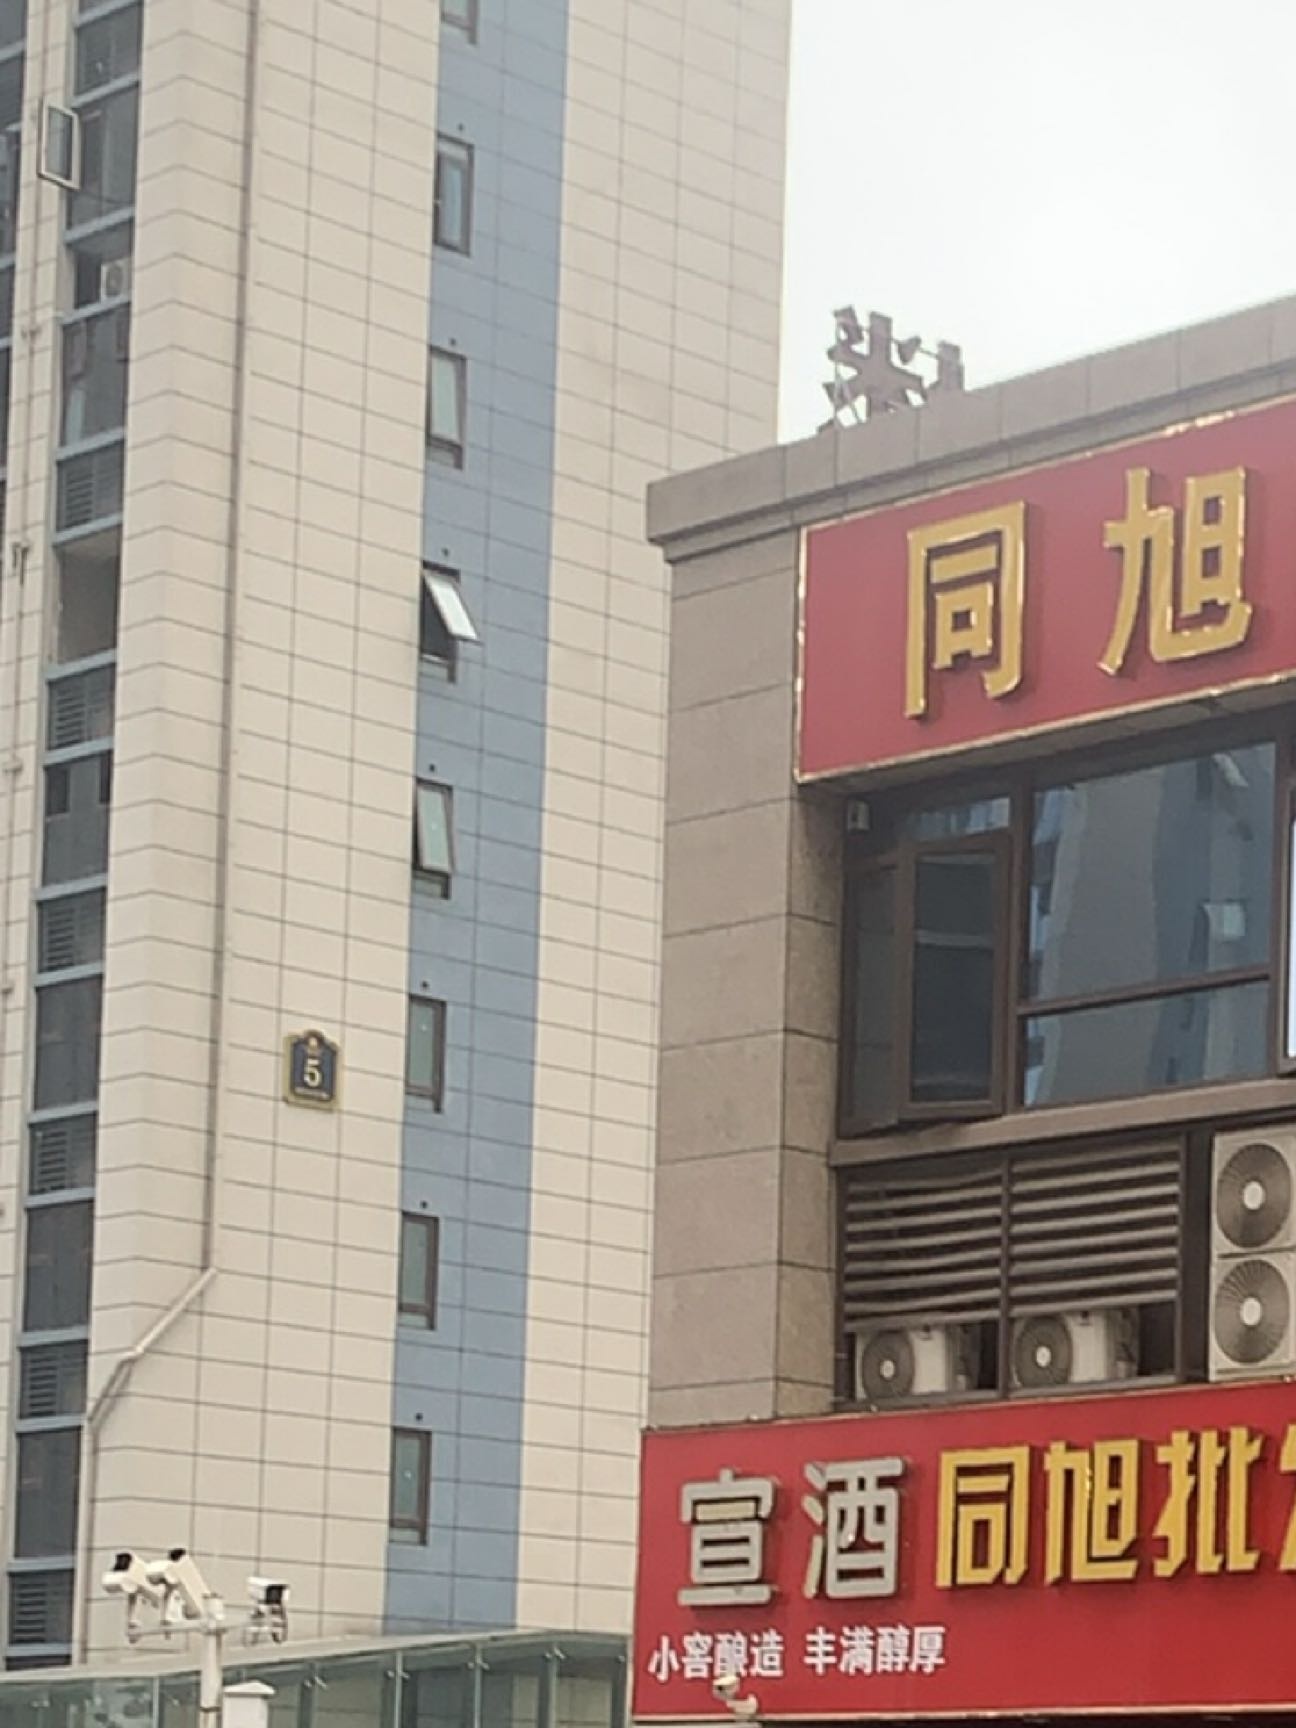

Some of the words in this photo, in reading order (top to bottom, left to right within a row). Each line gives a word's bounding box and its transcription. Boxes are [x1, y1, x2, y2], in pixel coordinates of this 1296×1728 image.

[677, 1456, 908, 1607] 宣酒
[647, 1628, 785, 1683] 小窖酿造
[803, 1622, 946, 1677] 丰满醇厚
